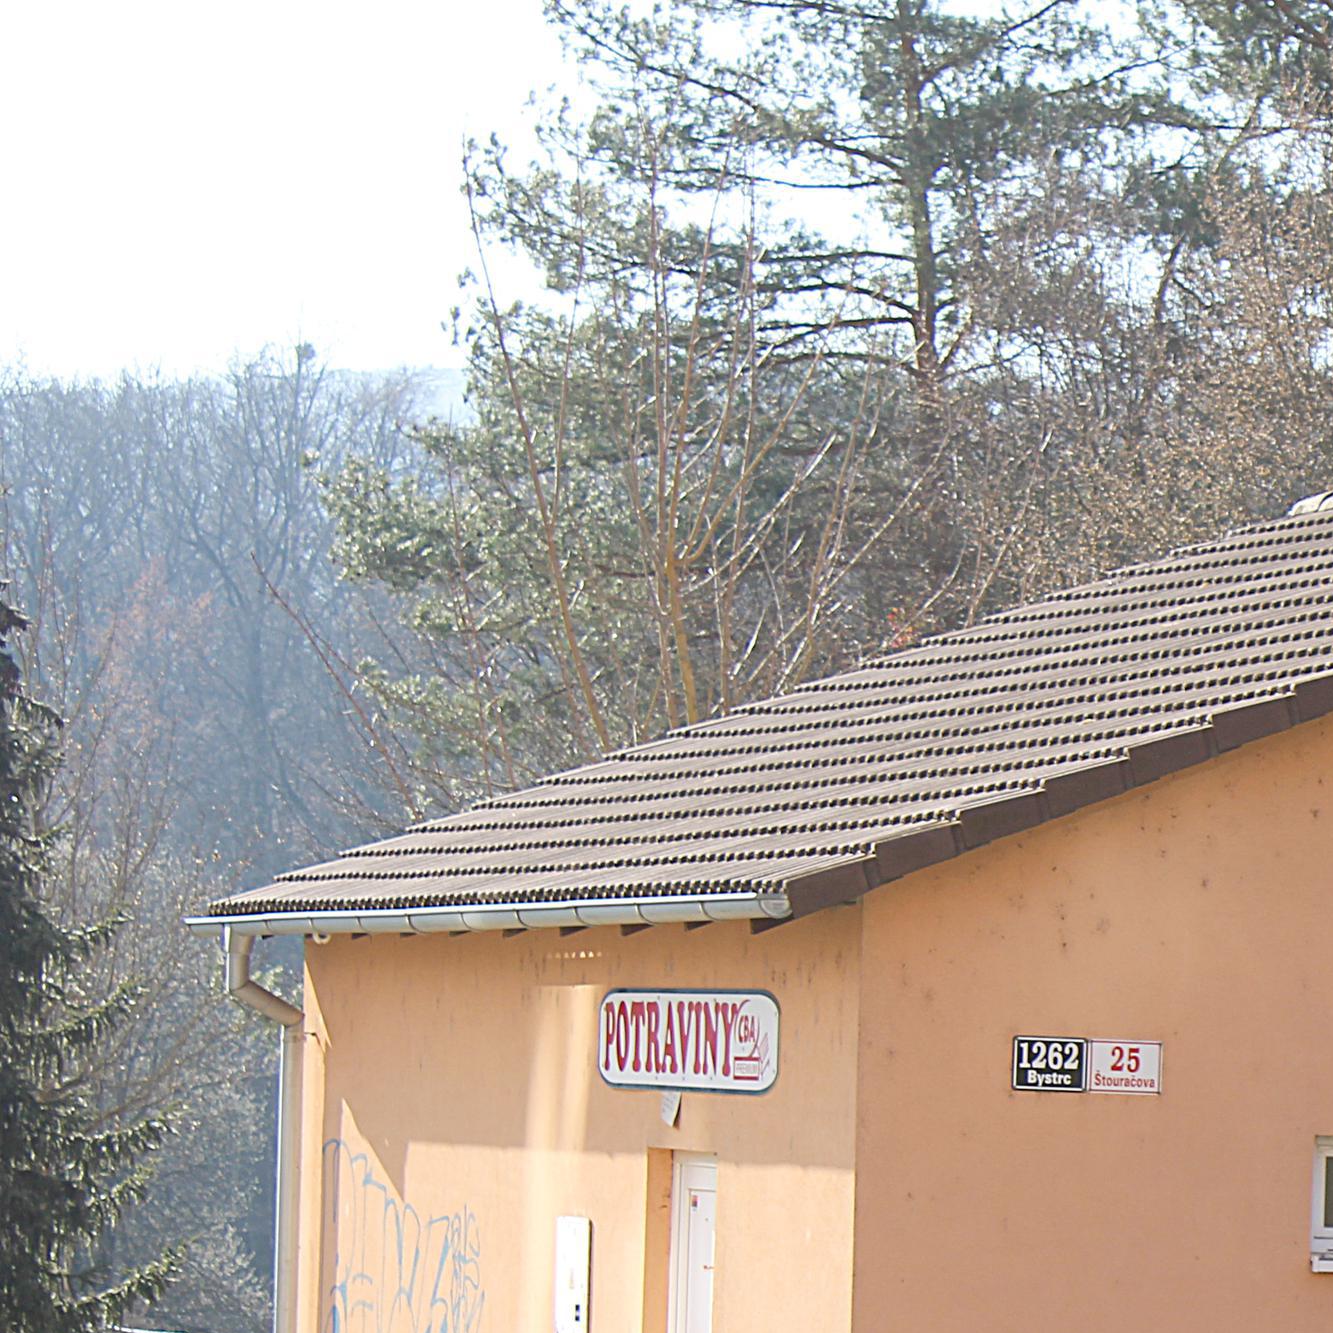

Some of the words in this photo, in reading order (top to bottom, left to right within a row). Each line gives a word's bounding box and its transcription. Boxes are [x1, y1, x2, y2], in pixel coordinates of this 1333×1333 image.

[604, 1000, 738, 1077] POTRAVINY
[738, 1015, 756, 1043] CBA
[1019, 1042, 1079, 1070] 1262
[1110, 1046, 1140, 1073] 25
[1027, 1070, 1072, 1087] Bystrc
[1094, 1070, 1155, 1088] Štouračova
